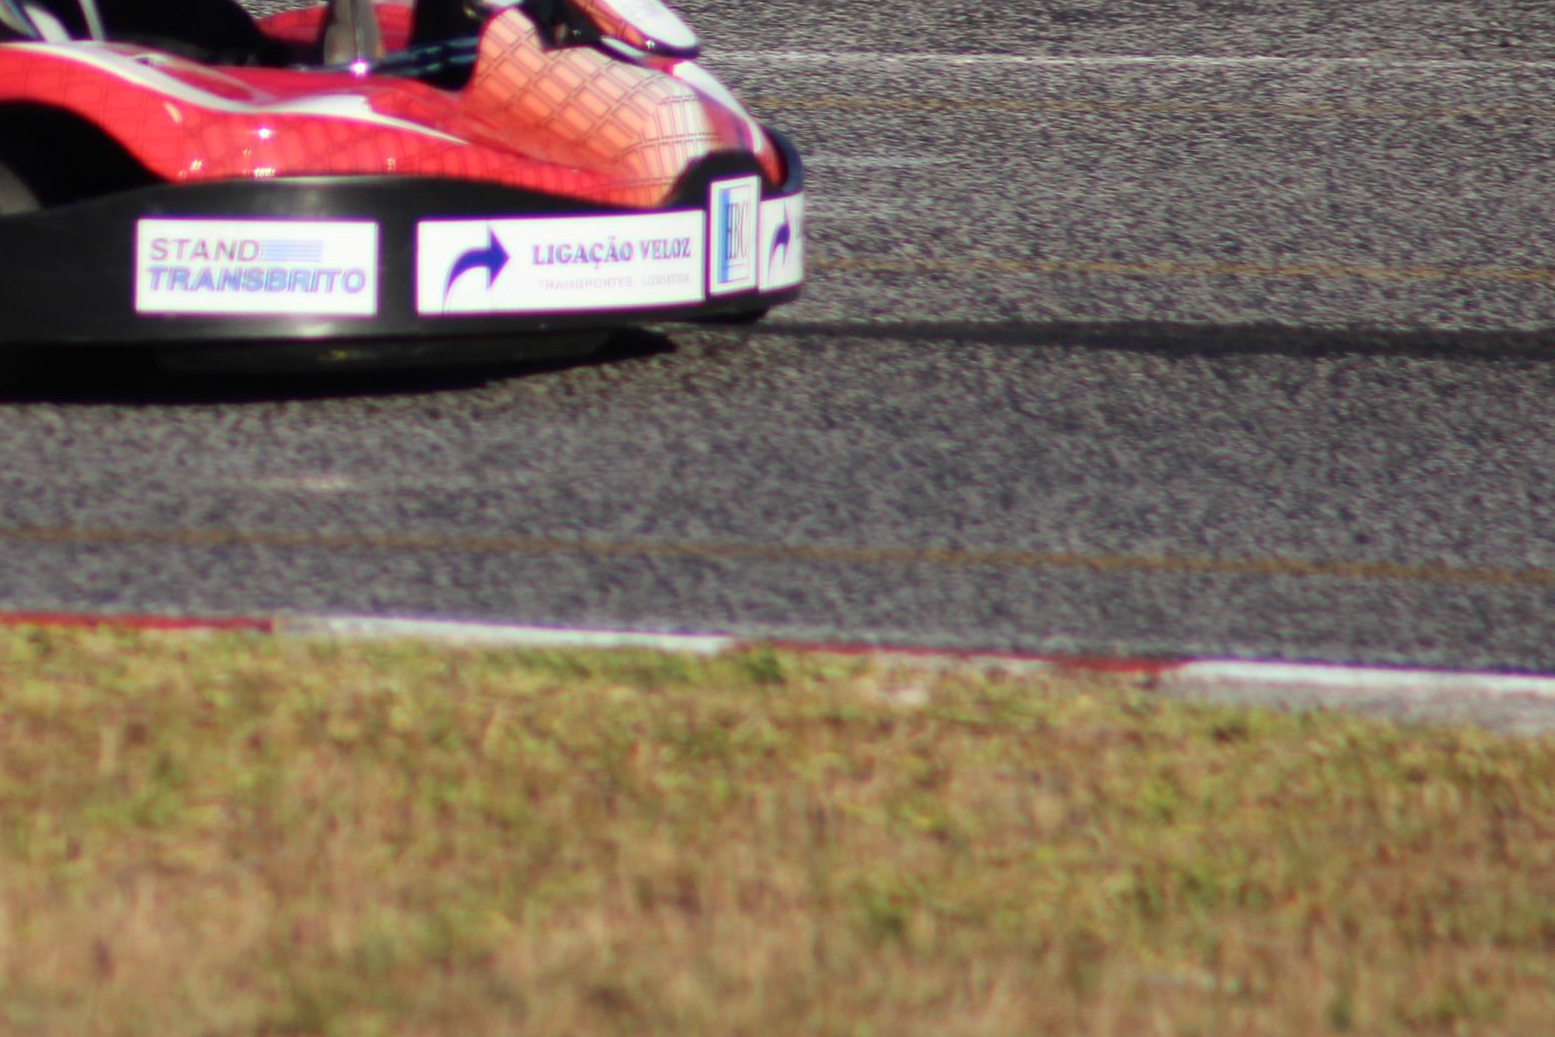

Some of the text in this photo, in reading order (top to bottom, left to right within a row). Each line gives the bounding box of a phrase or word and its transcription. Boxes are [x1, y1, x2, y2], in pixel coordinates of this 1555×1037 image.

[149, 238, 261, 263] STAND
[531, 235, 691, 270] LIGAÇÃO VELOZ
[147, 266, 367, 294] TRANSBRITO
